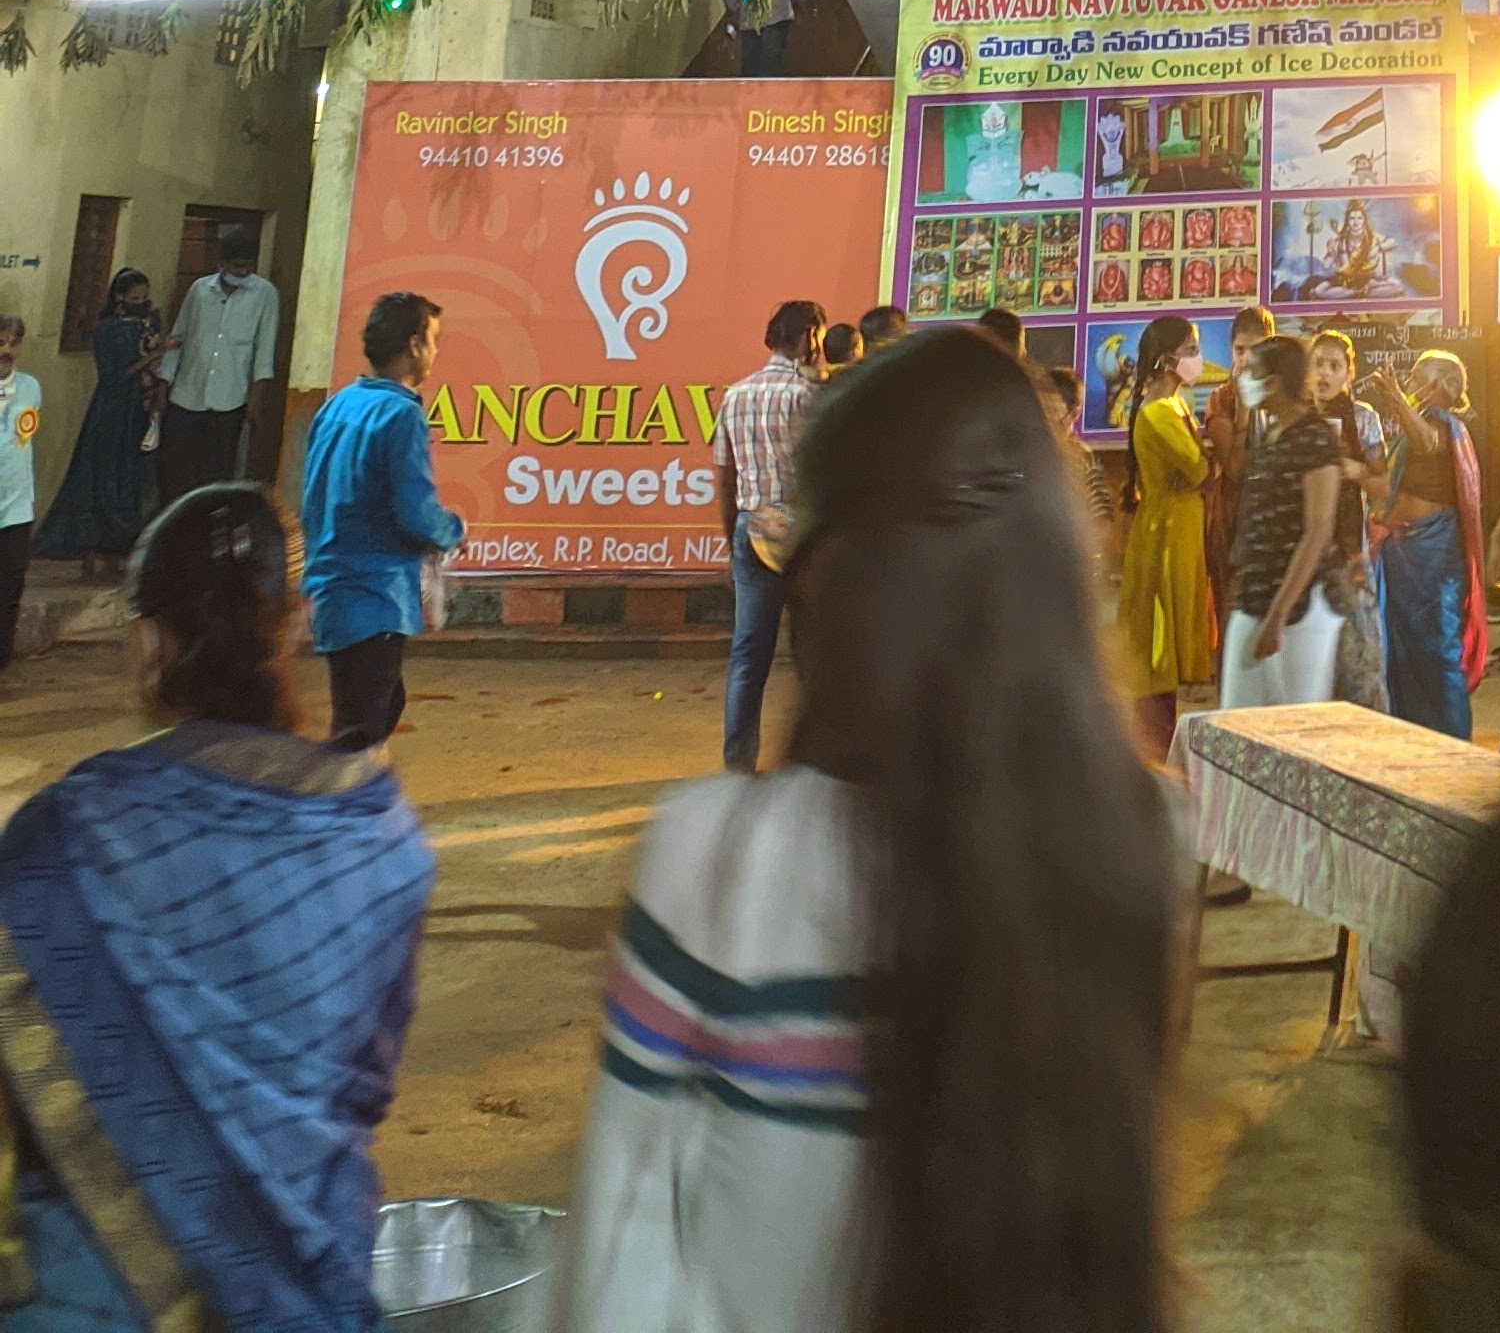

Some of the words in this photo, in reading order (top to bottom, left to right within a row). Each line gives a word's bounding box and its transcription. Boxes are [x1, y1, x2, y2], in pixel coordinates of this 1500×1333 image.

[1101, 23, 1251, 54] నవయువక్
[1257, 18, 1334, 47] గణేష్
[1339, 15, 1444, 43] మండల్
[928, 43, 957, 67] 90
[977, 64, 1040, 87] Every
[1046, 60, 1089, 85] Day
[1095, 60, 1143, 82] New
[1150, 55, 1245, 82] Concept
[1251, 52, 1274, 74] of
[1279, 52, 1313, 73] Ice
[1319, 50, 1444, 73] Decoration
[395, 111, 498, 135] Ravinder
[504, 111, 568, 140] Singh
[747, 109, 826, 133] Dinesh
[833, 108, 892, 139] Singh
[419, 145, 488, 168] 94410
[495, 145, 564, 168] 41396
[748, 144, 818, 167] 94407
[426, 383, 731, 445] ANCHAV
[503, 455, 716, 506] Sweets
[552, 536, 594, 563] R.P.
[600, 536, 674, 568] Road,
